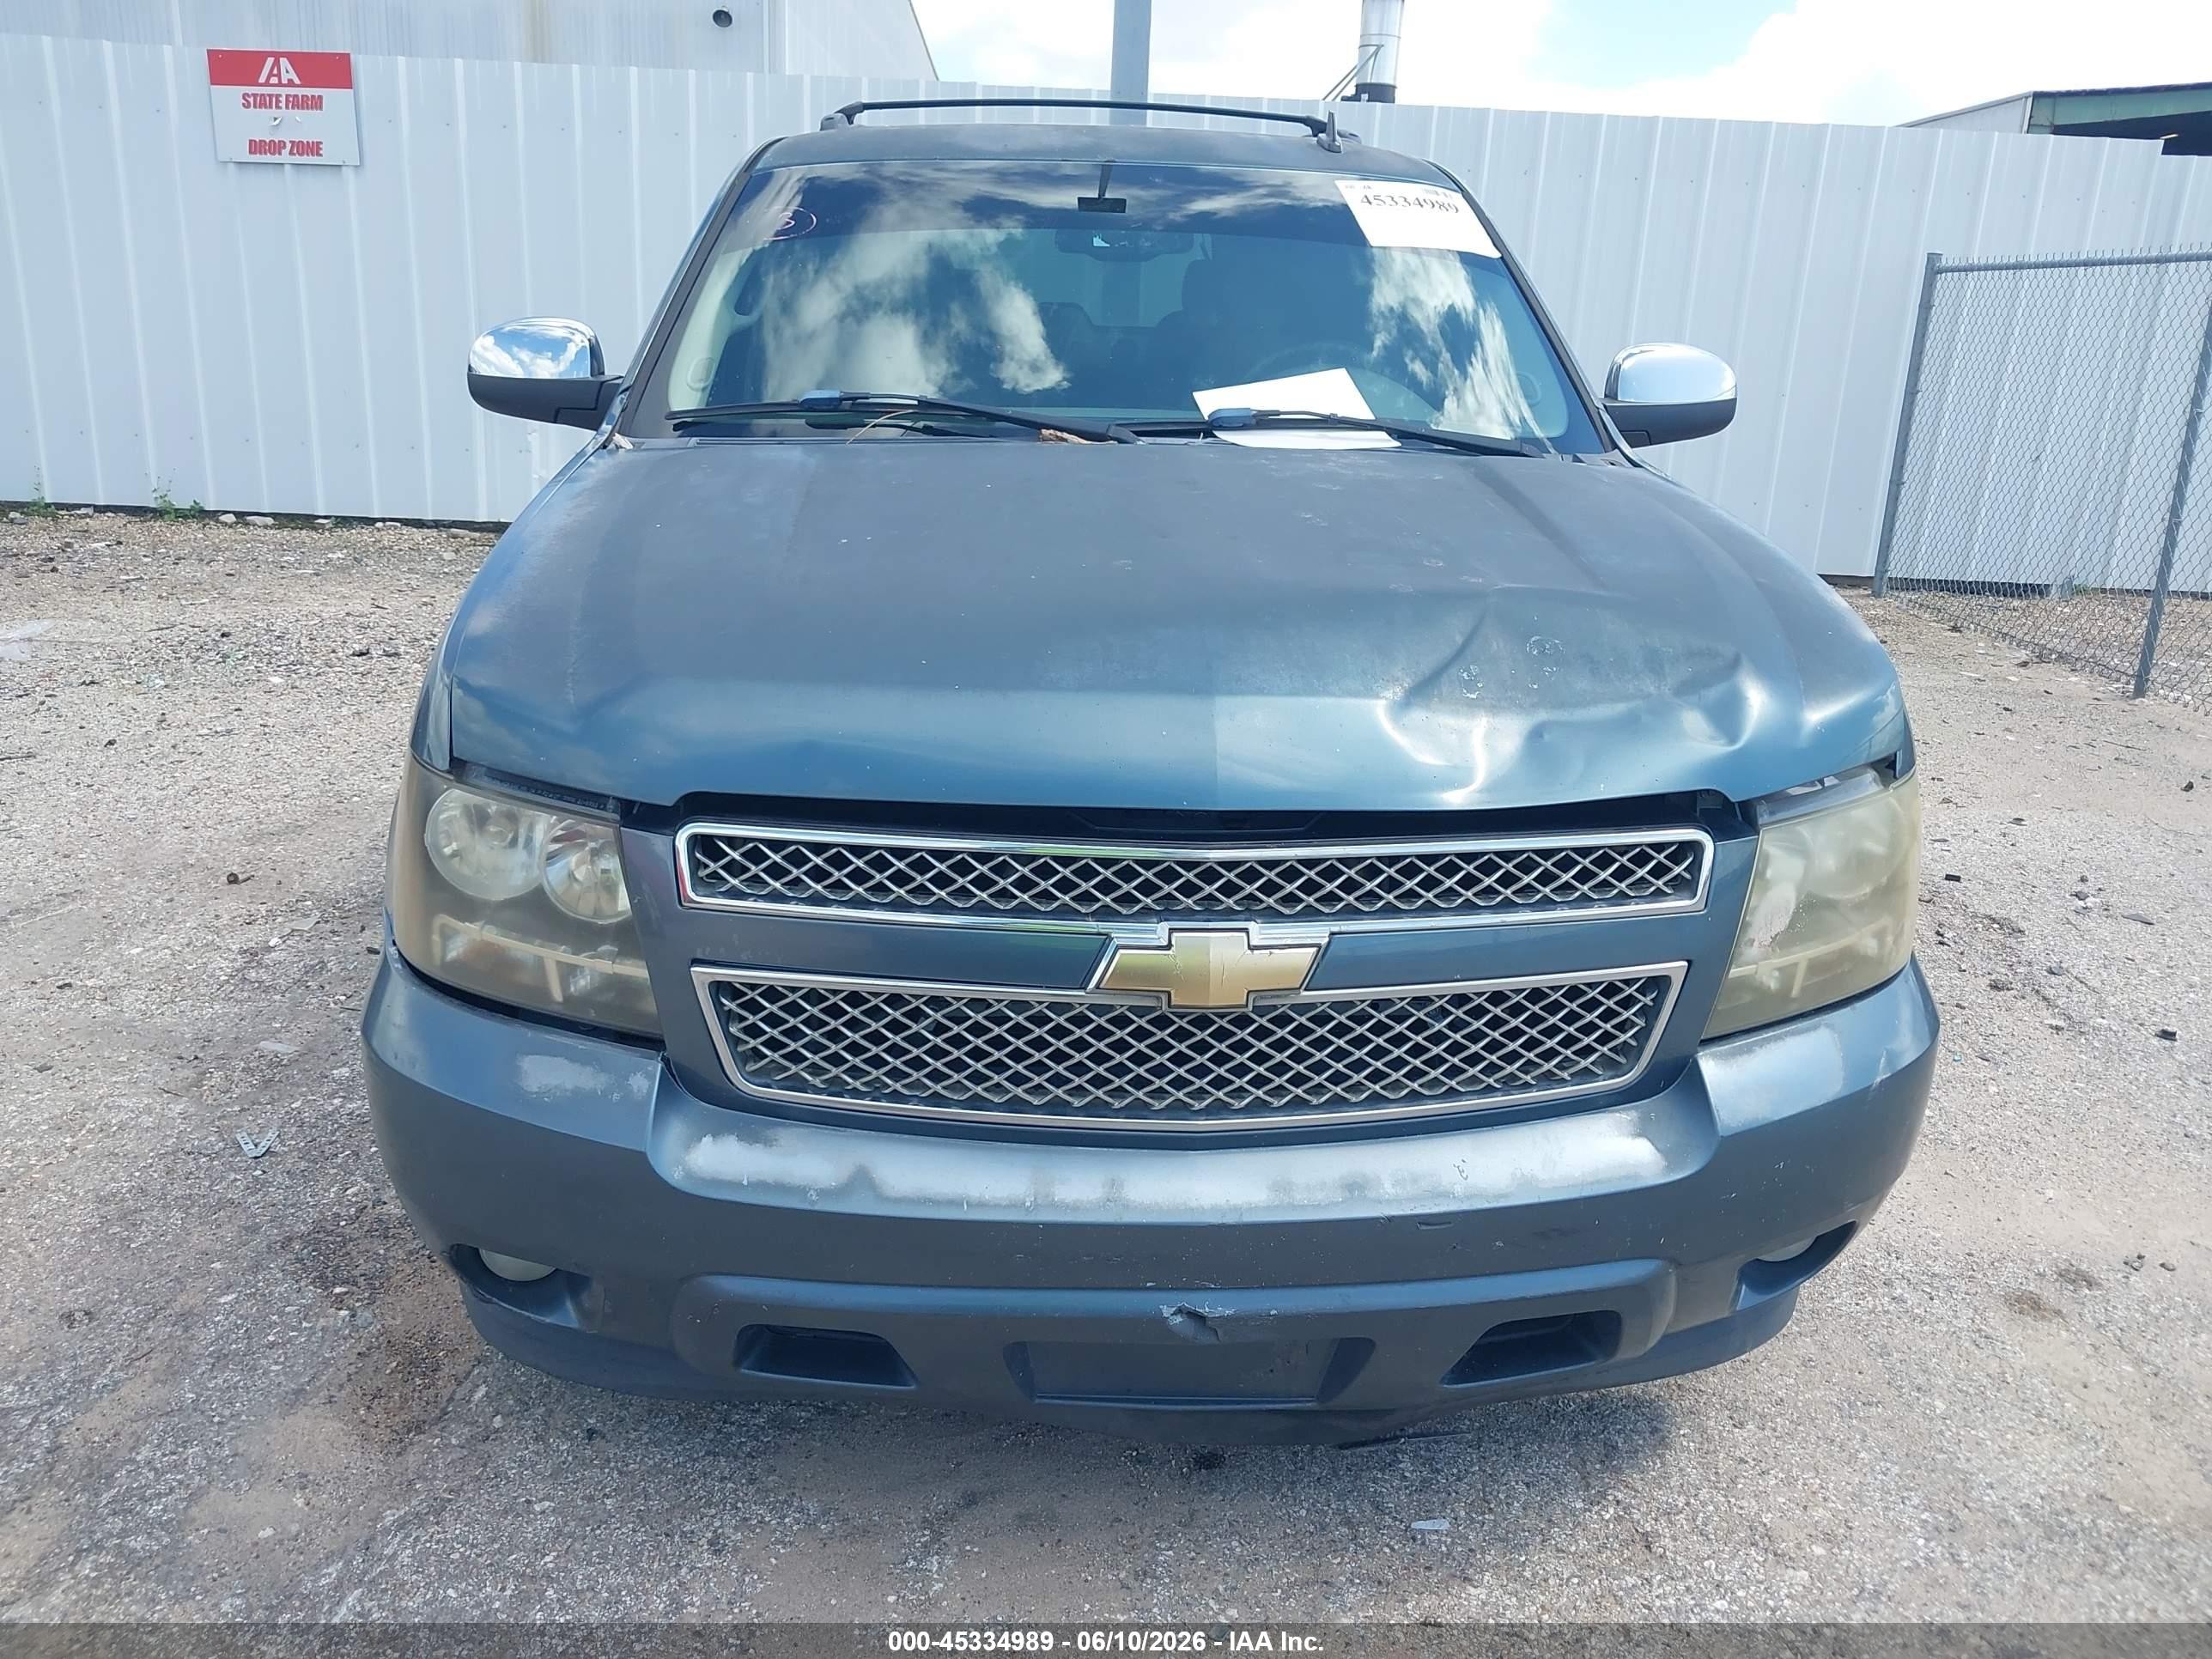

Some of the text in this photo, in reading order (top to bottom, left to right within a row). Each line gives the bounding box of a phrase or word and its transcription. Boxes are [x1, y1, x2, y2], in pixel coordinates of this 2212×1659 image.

[241, 92, 324, 112] STATE FARM
[247, 138, 324, 158] DROP ZONE
[1360, 194, 1459, 214] 45334989
